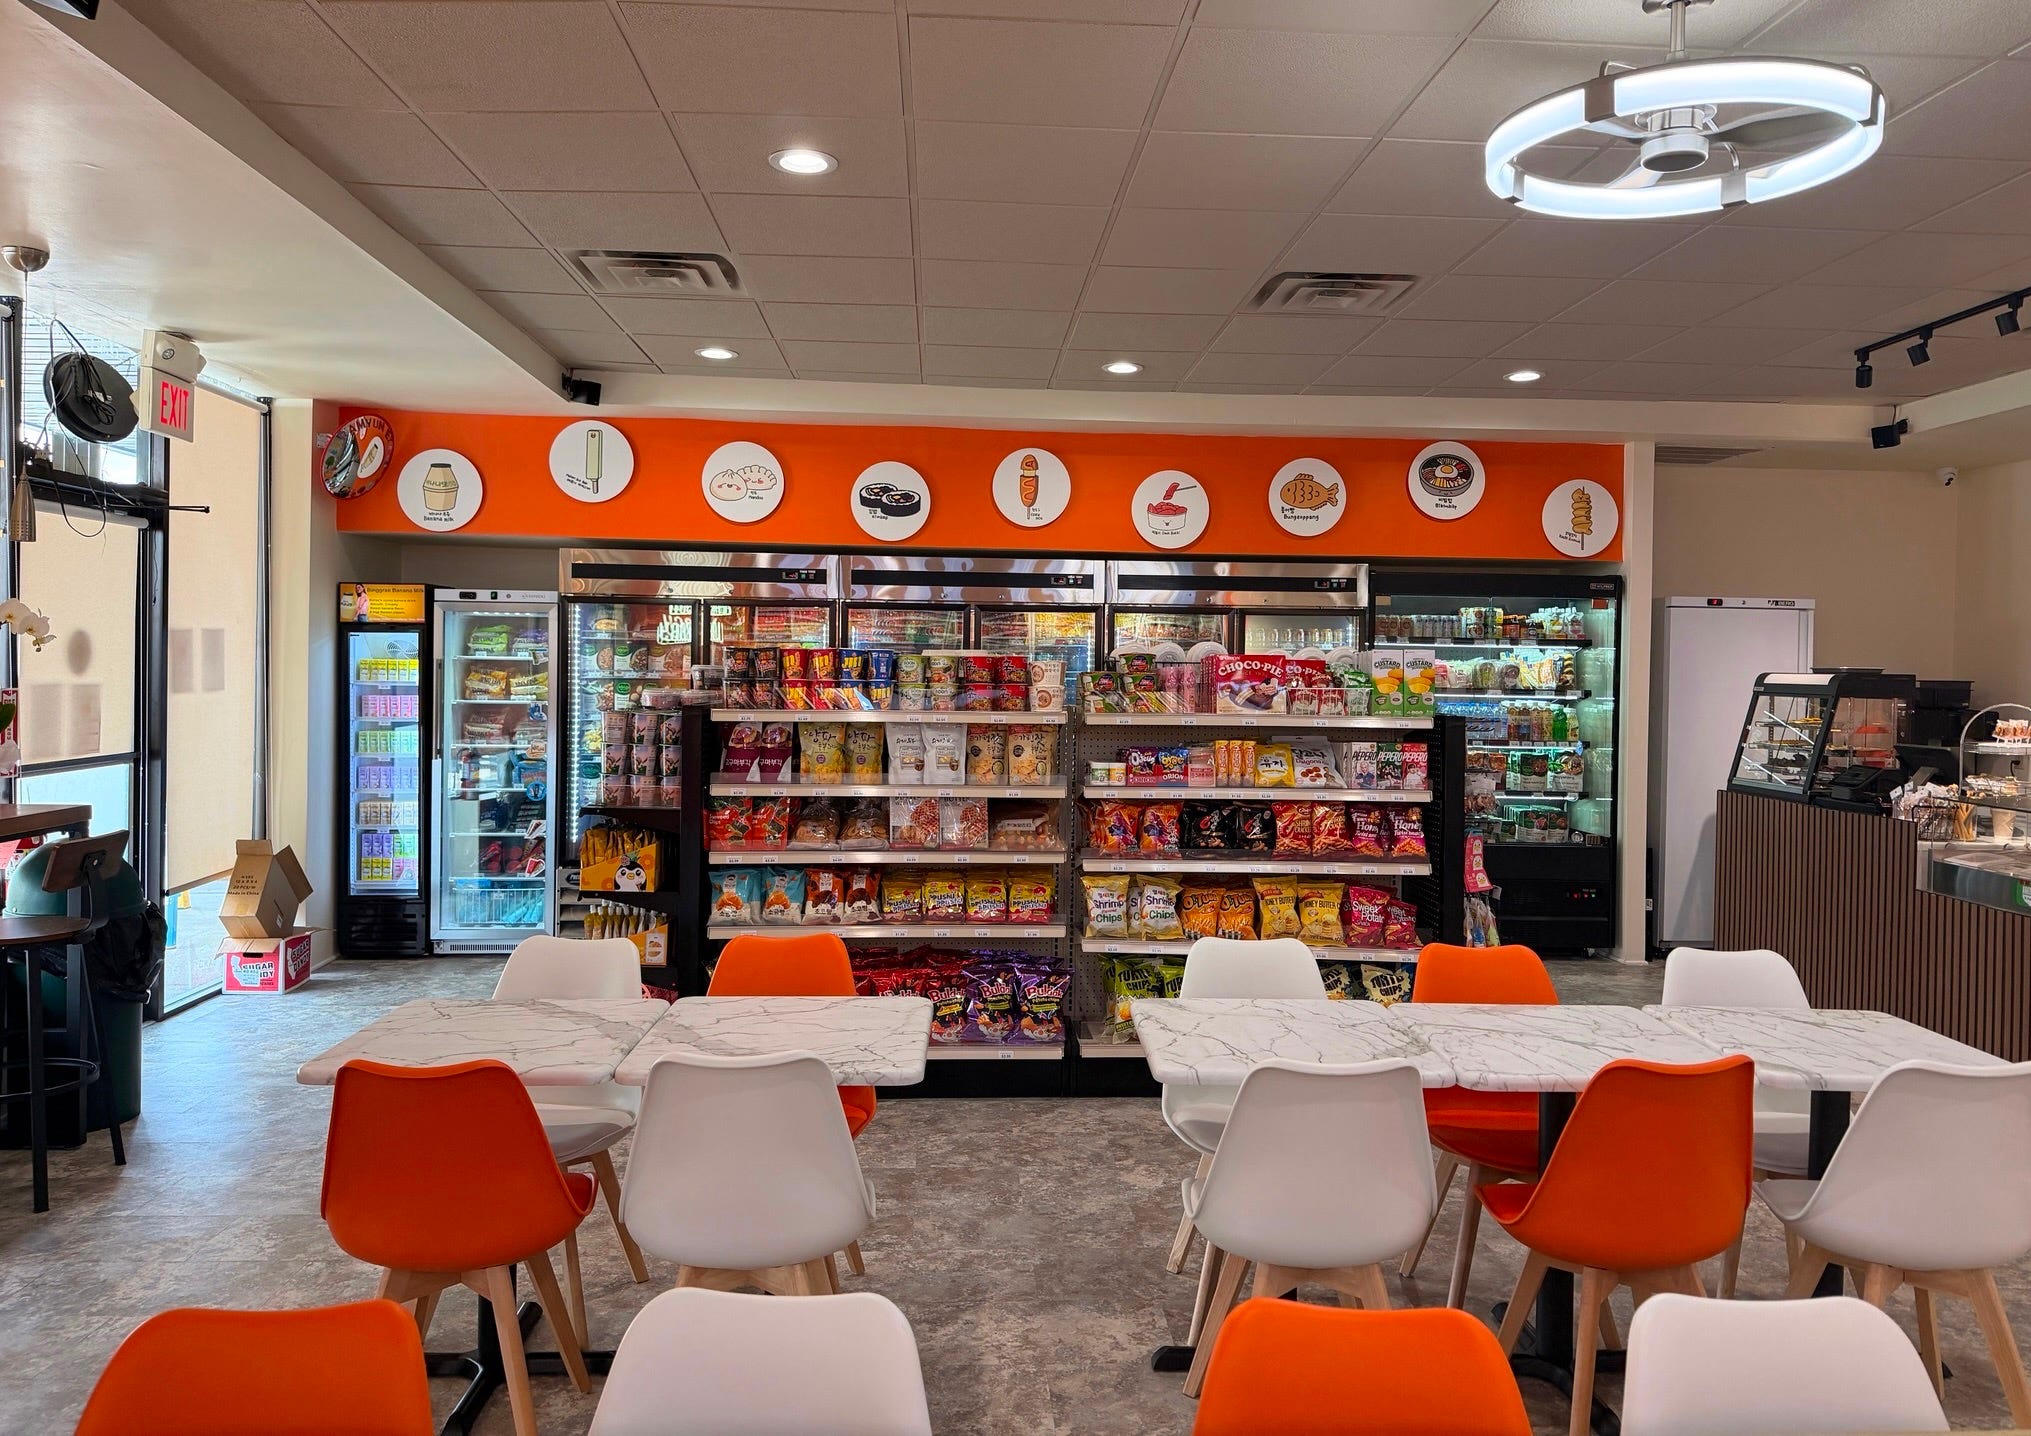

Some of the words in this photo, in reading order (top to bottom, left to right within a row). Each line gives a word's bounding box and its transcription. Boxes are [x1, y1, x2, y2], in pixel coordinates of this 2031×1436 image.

[160, 381, 190, 432] EXIT
[1374, 660, 1401, 669] CUSTARD
[1406, 660, 1433, 669] CUSTARD
[1352, 751, 1377, 761] PEPERO
[1377, 751, 1403, 761] PEPERO
[1402, 752, 1428, 762] PEPERO
[1094, 899, 1124, 909] Shrimp
[1318, 900, 1336, 909] BUTTER
[1352, 901, 1379, 914] Sweet
[1095, 913, 1123, 923] Chips
[1149, 909, 1175, 920] Chips
[291, 939, 310, 959] SUGAR
[1126, 980, 1152, 991] CHIPS
[1370, 974, 1405, 988] TURTLE
[1025, 985, 1064, 998] Buldak
[1380, 984, 1402, 996] CHIPS
